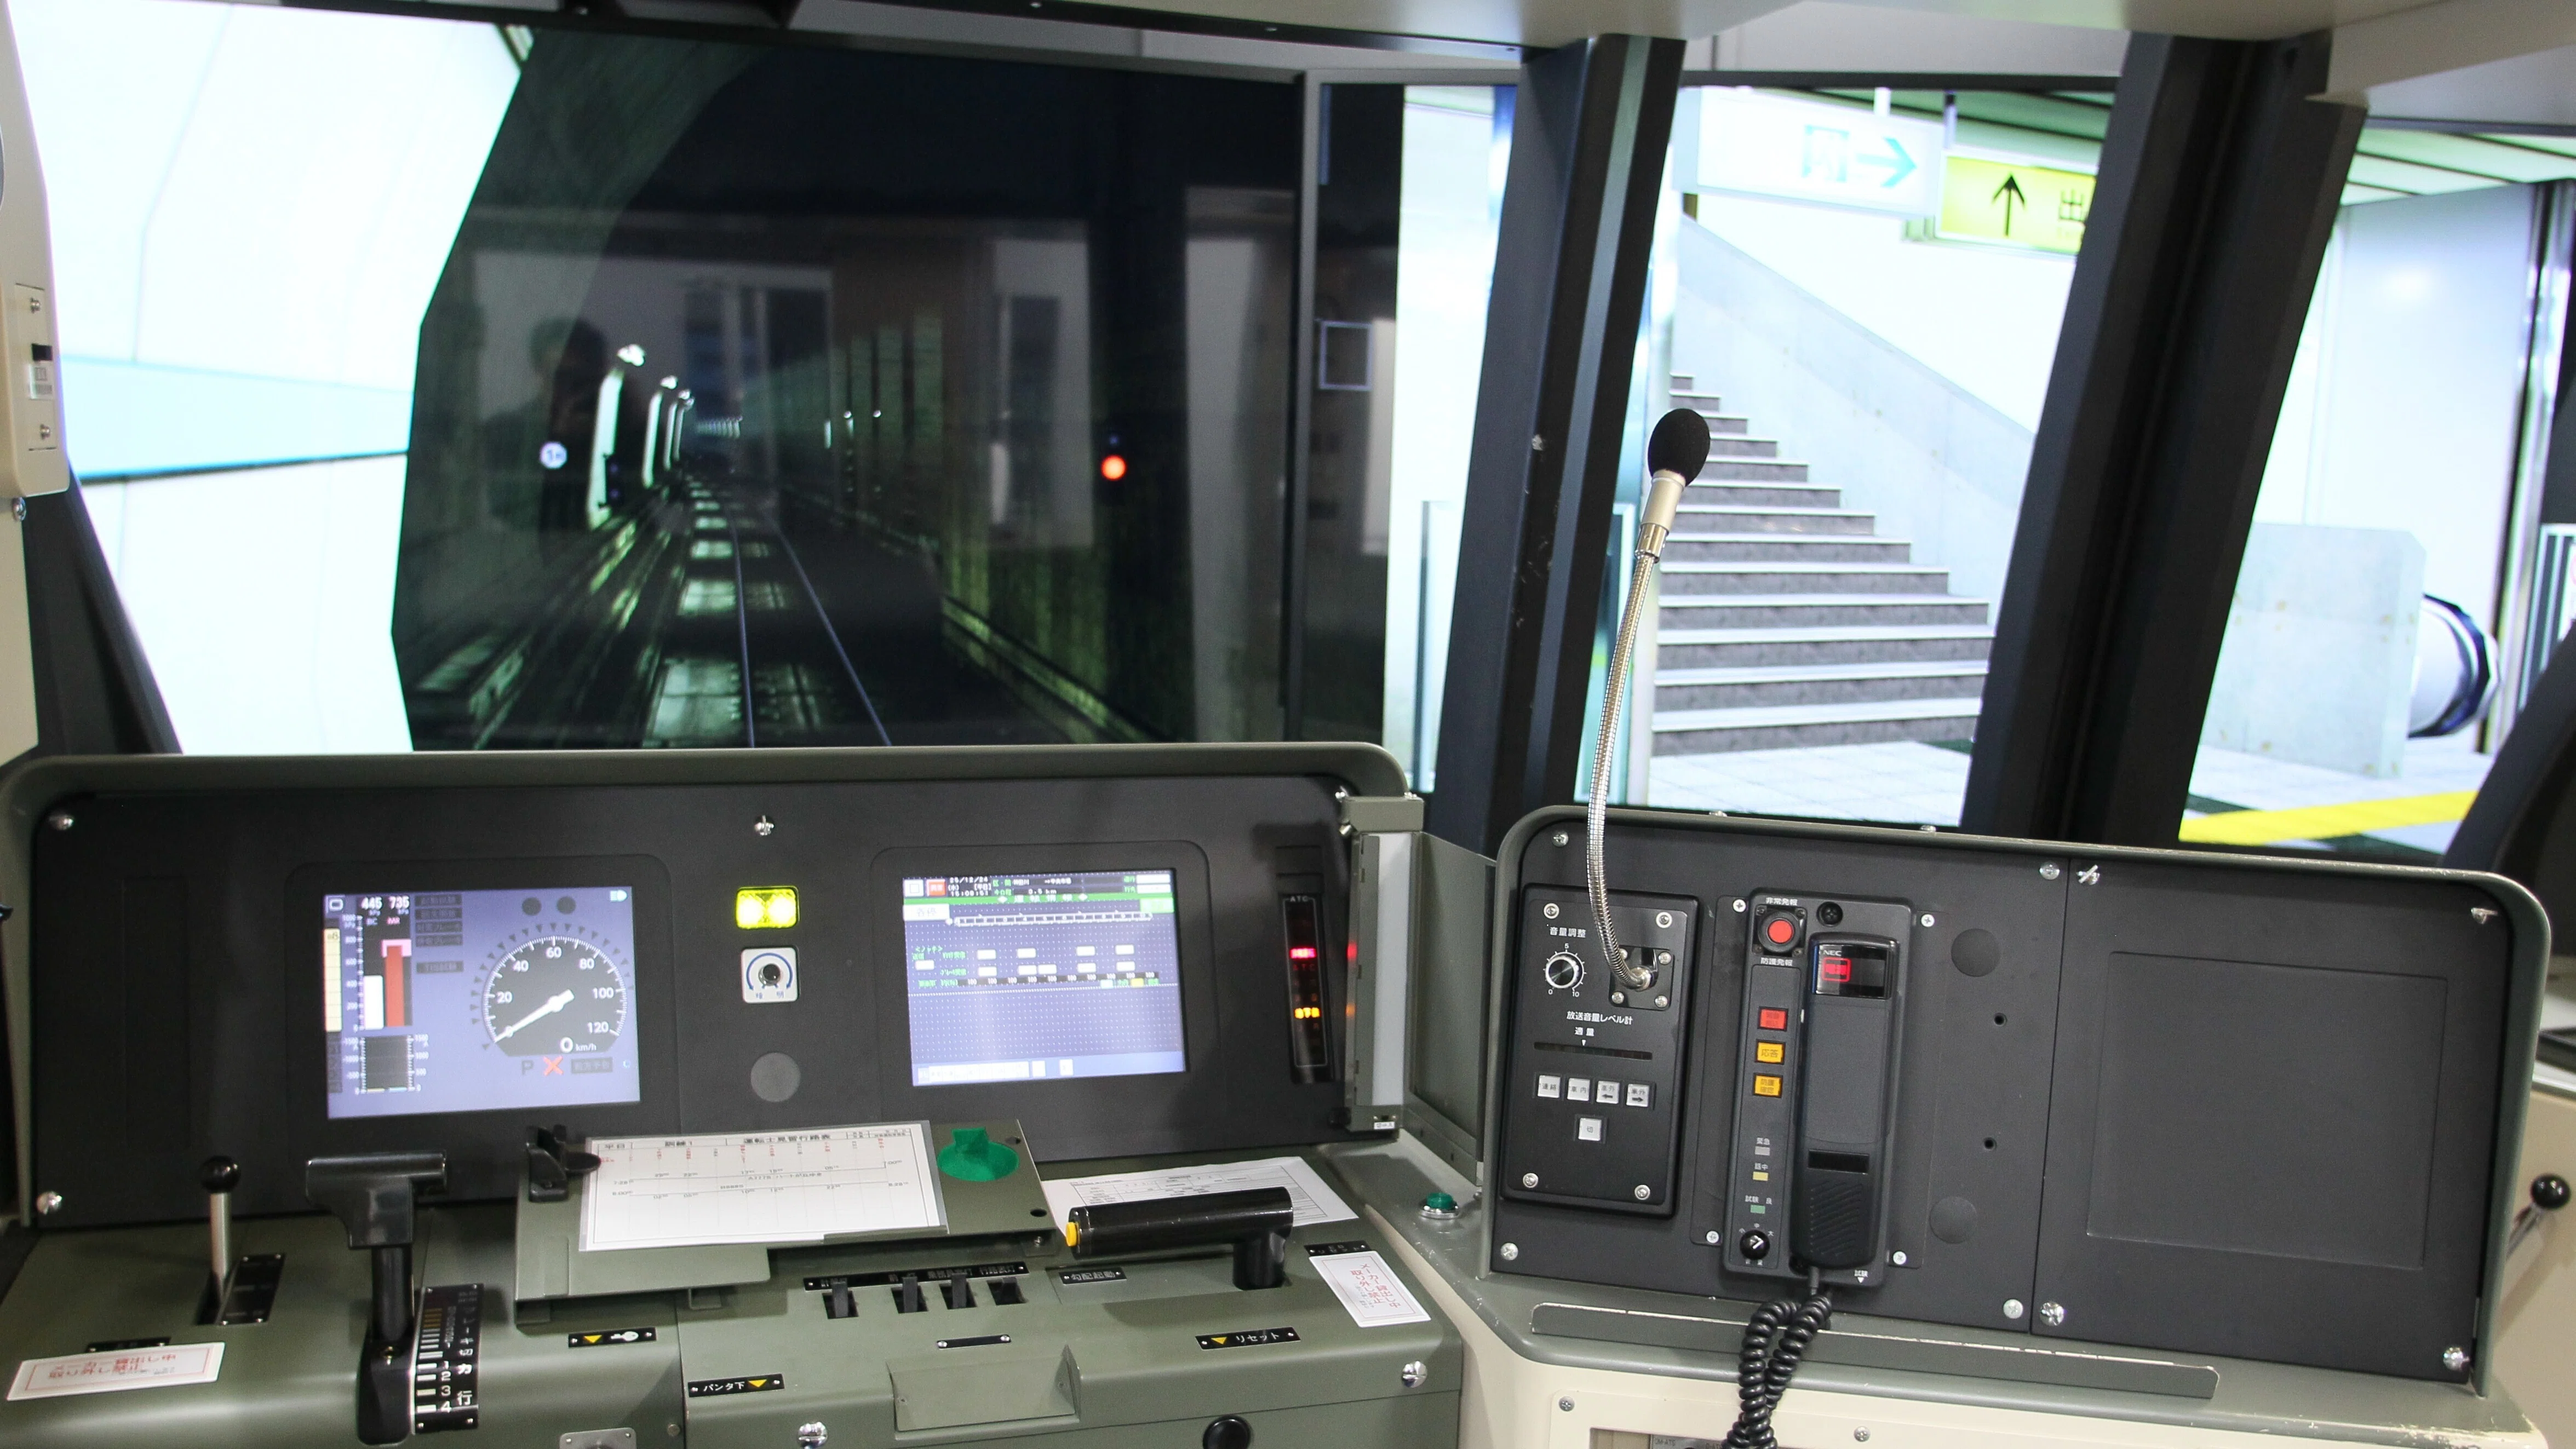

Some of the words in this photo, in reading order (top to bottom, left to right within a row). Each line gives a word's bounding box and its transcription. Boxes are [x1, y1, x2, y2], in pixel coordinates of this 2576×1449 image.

[2058, 188, 2085, 221] 出
[361, 896, 382, 910] 445
[389, 895, 410, 909] 735
[1765, 897, 1798, 906] 非常発報
[1550, 927, 1586, 938] 音量調整
[547, 947, 562, 958] 60
[513, 960, 529, 972] 40
[579, 958, 595, 971] 80
[1760, 957, 1793, 967] 防護発報
[497, 991, 513, 1004] 20
[593, 987, 614, 999] 100
[1567, 1011, 1633, 1025] 放送音量レベル計
[587, 1022, 609, 1034] 120
[560, 1037, 573, 1053] 0
[576, 1043, 597, 1051] km/h
[1761, 1048, 1778, 1058] 応答
[521, 1060, 534, 1075] P
[1756, 1137, 1770, 1146] 緊急
[1745, 1195, 1759, 1203] 試験
[1071, 1270, 1116, 1280] 勾配起動
[1236, 1332, 1279, 1343] リセット
[443, 1361, 450, 1370] 1
[441, 1371, 451, 1381] 2
[441, 1385, 451, 1396] 3
[703, 1381, 745, 1392] パンタ下
[440, 1401, 452, 1413] 4
